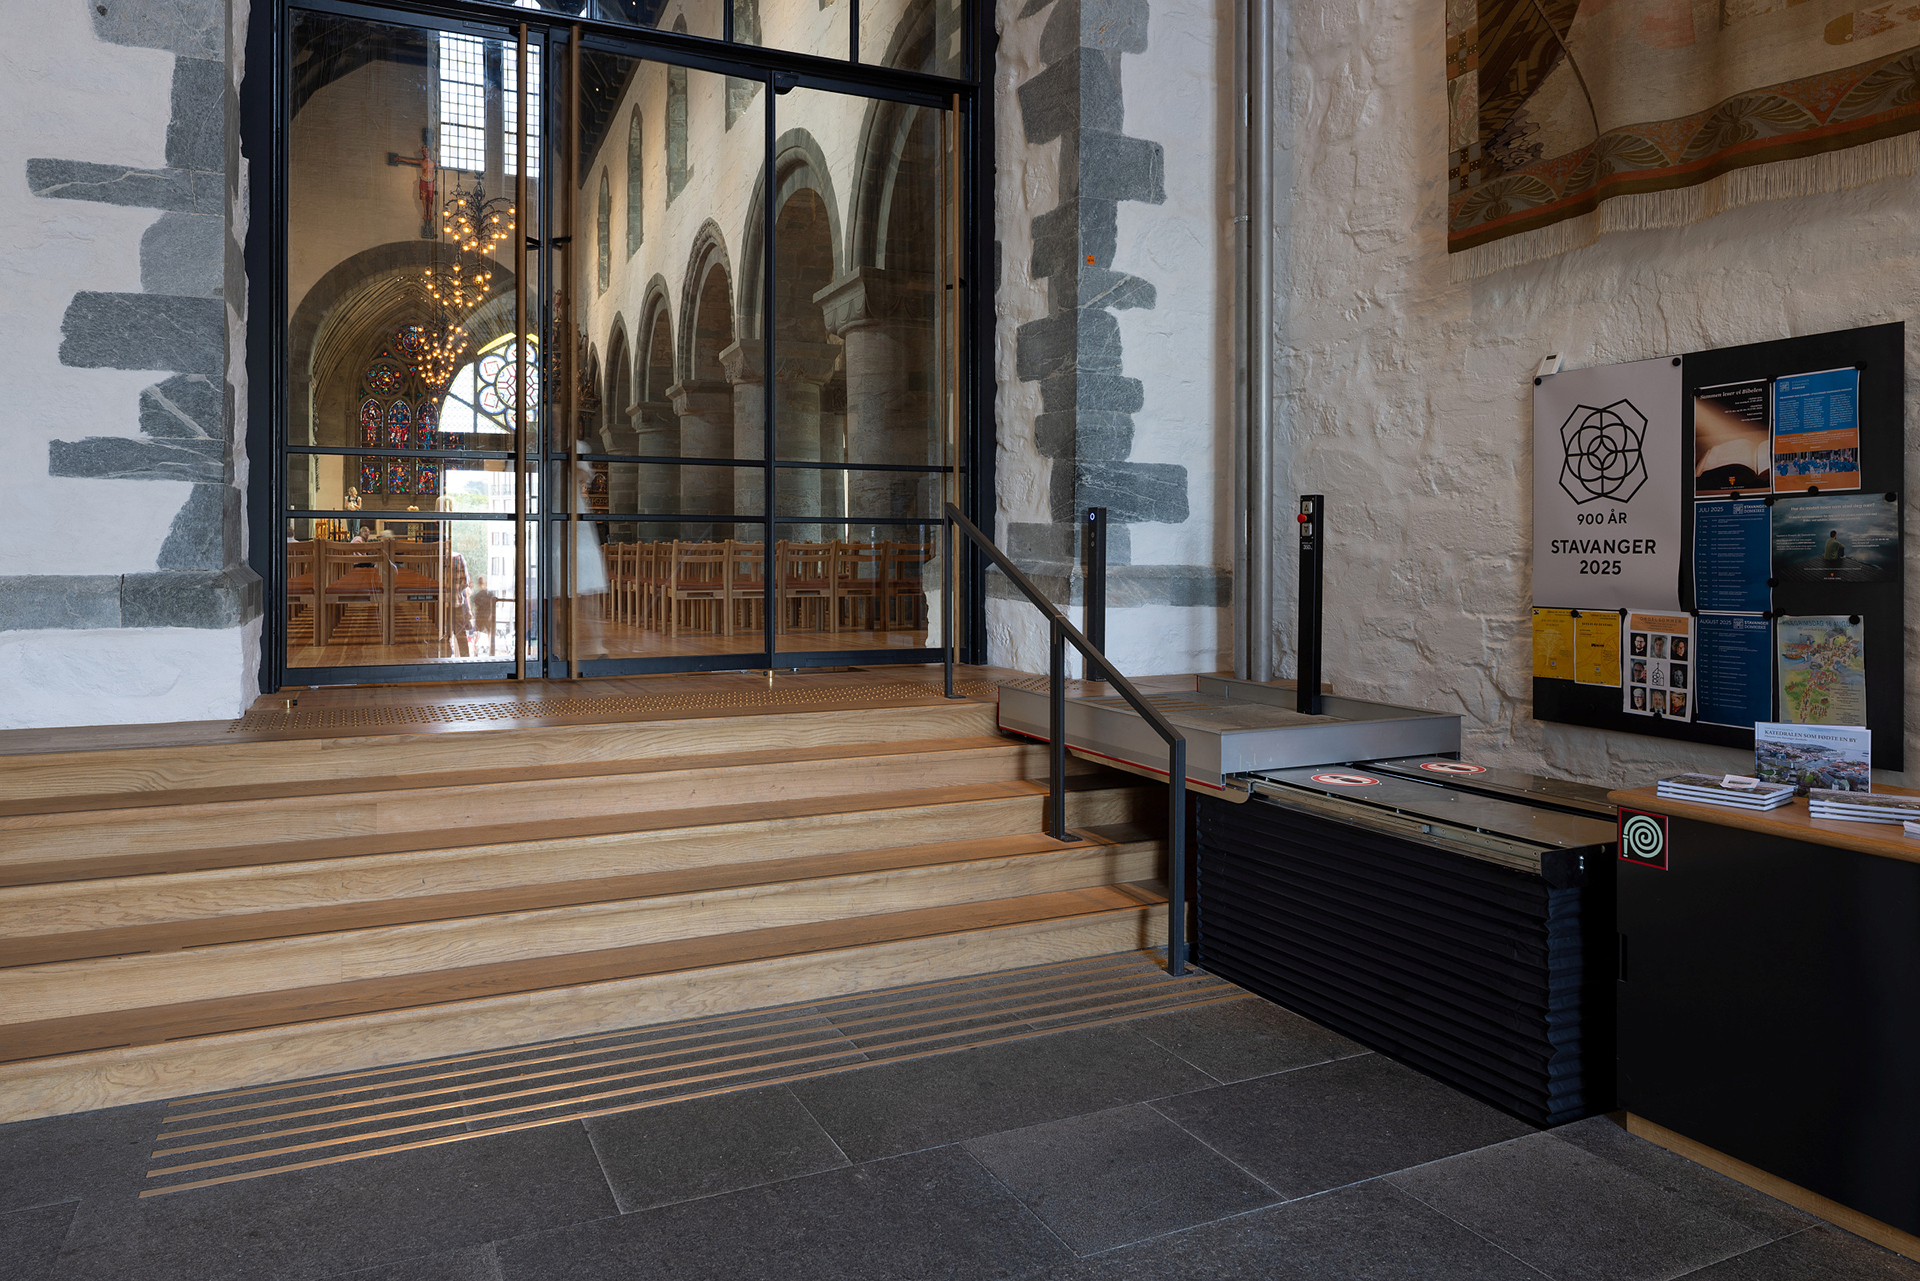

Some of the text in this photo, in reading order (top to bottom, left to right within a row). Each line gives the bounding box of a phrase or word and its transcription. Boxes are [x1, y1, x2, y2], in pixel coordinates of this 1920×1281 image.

[1577, 508, 1628, 525] 900 ÅR
[1551, 539, 1657, 554] STAVANGER
[1579, 559, 1622, 575] 2025
[1764, 729, 1803, 738] KATEDRALEN
